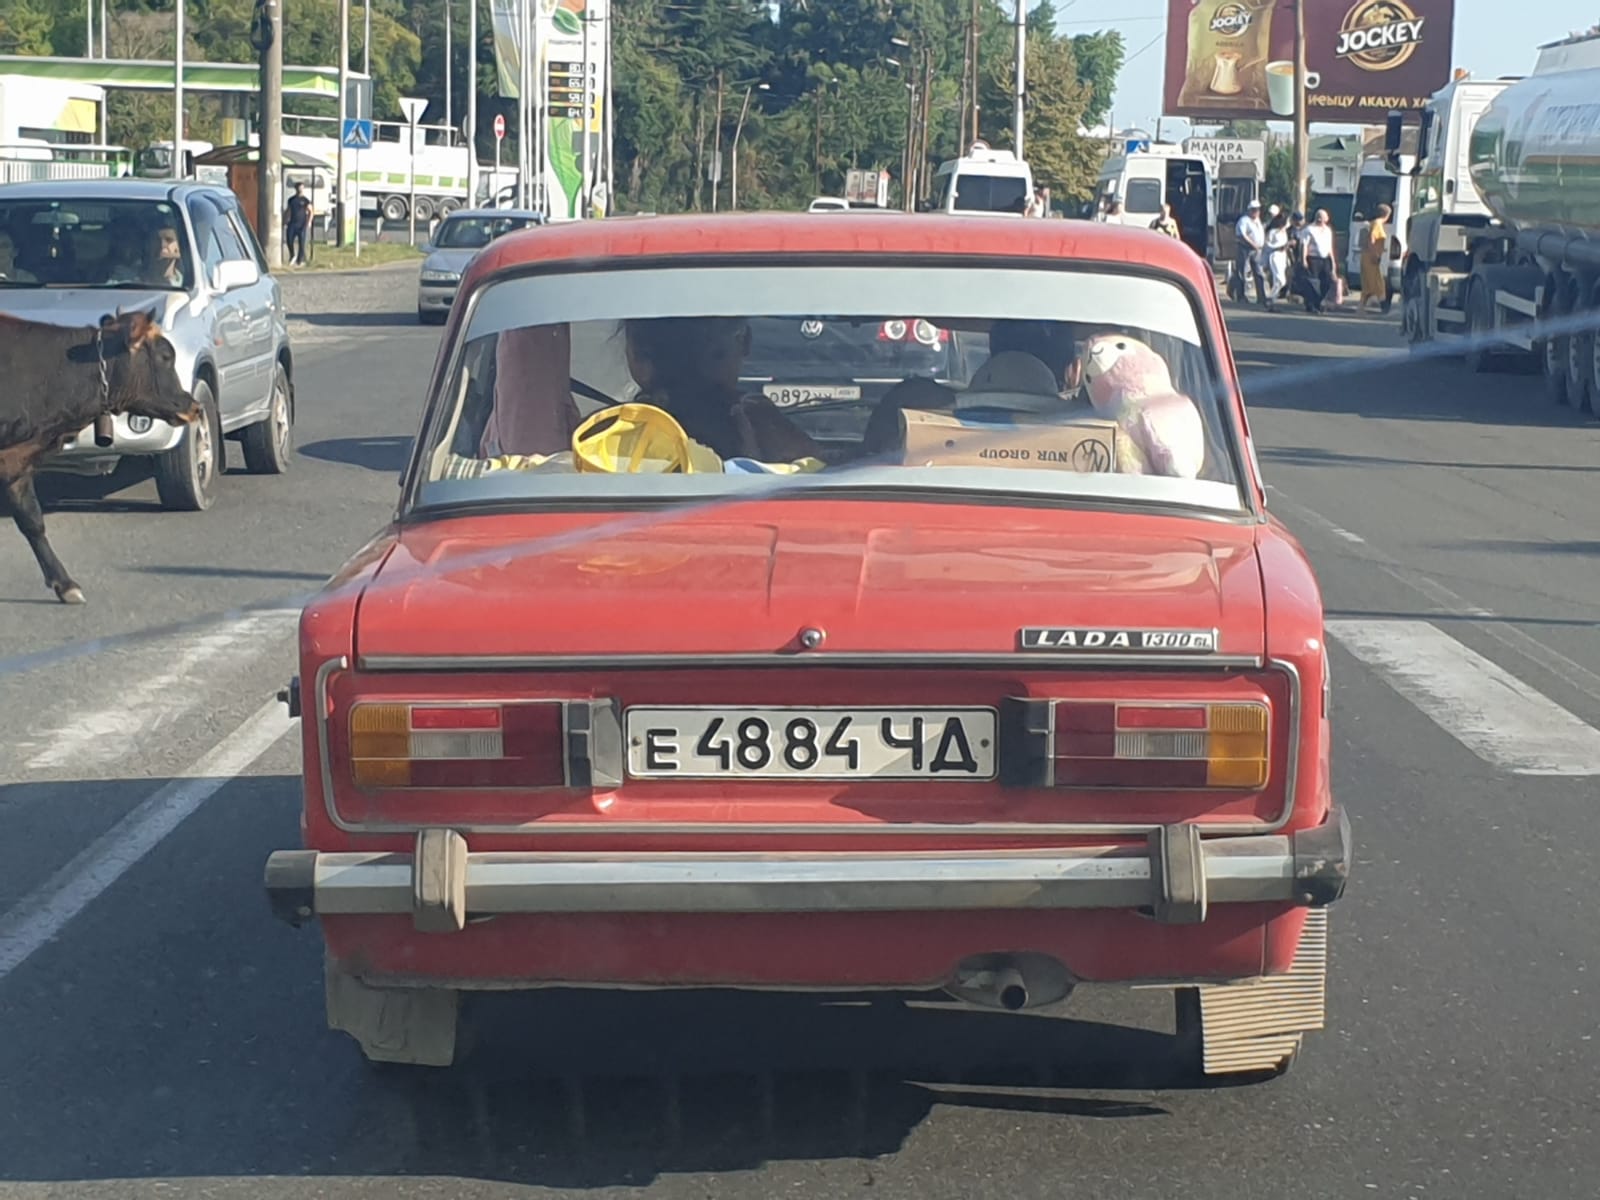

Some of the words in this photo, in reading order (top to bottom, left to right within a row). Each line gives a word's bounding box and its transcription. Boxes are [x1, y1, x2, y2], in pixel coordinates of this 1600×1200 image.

[1336, 19, 1424, 54] JOCKEY
[1191, 141, 1243, 153] МАЧАРА
[979, 447, 1030, 460] GROUP
[1037, 449, 1068, 463] NUR
[1037, 630, 1131, 648] LADA
[1146, 632, 1192, 647] 1300
[881, 716, 978, 774] ЧД
